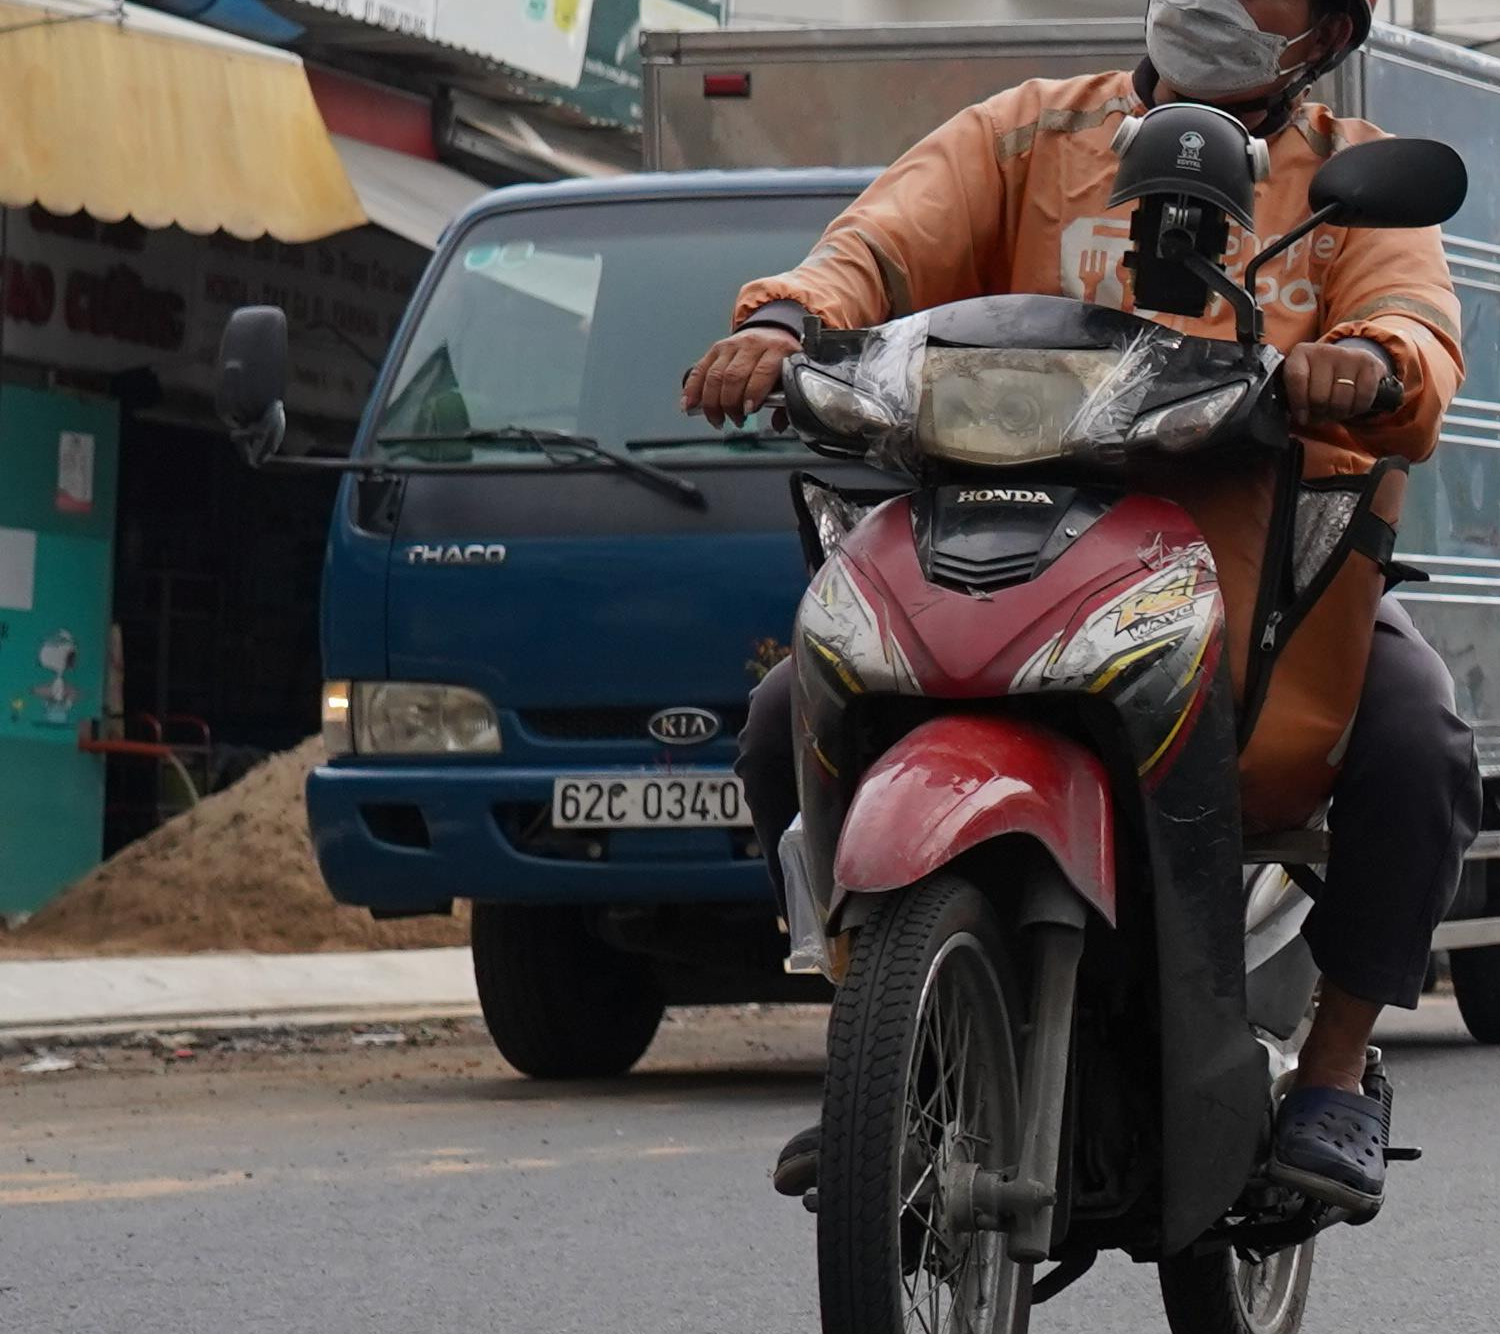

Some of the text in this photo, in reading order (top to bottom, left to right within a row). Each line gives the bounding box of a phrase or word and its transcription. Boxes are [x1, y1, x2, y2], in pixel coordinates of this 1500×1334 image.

[957, 489, 1054, 505] HONDA
[405, 544, 506, 565] THACO
[661, 716, 708, 736] KIA
[561, 781, 740, 822] 62C 034.0
